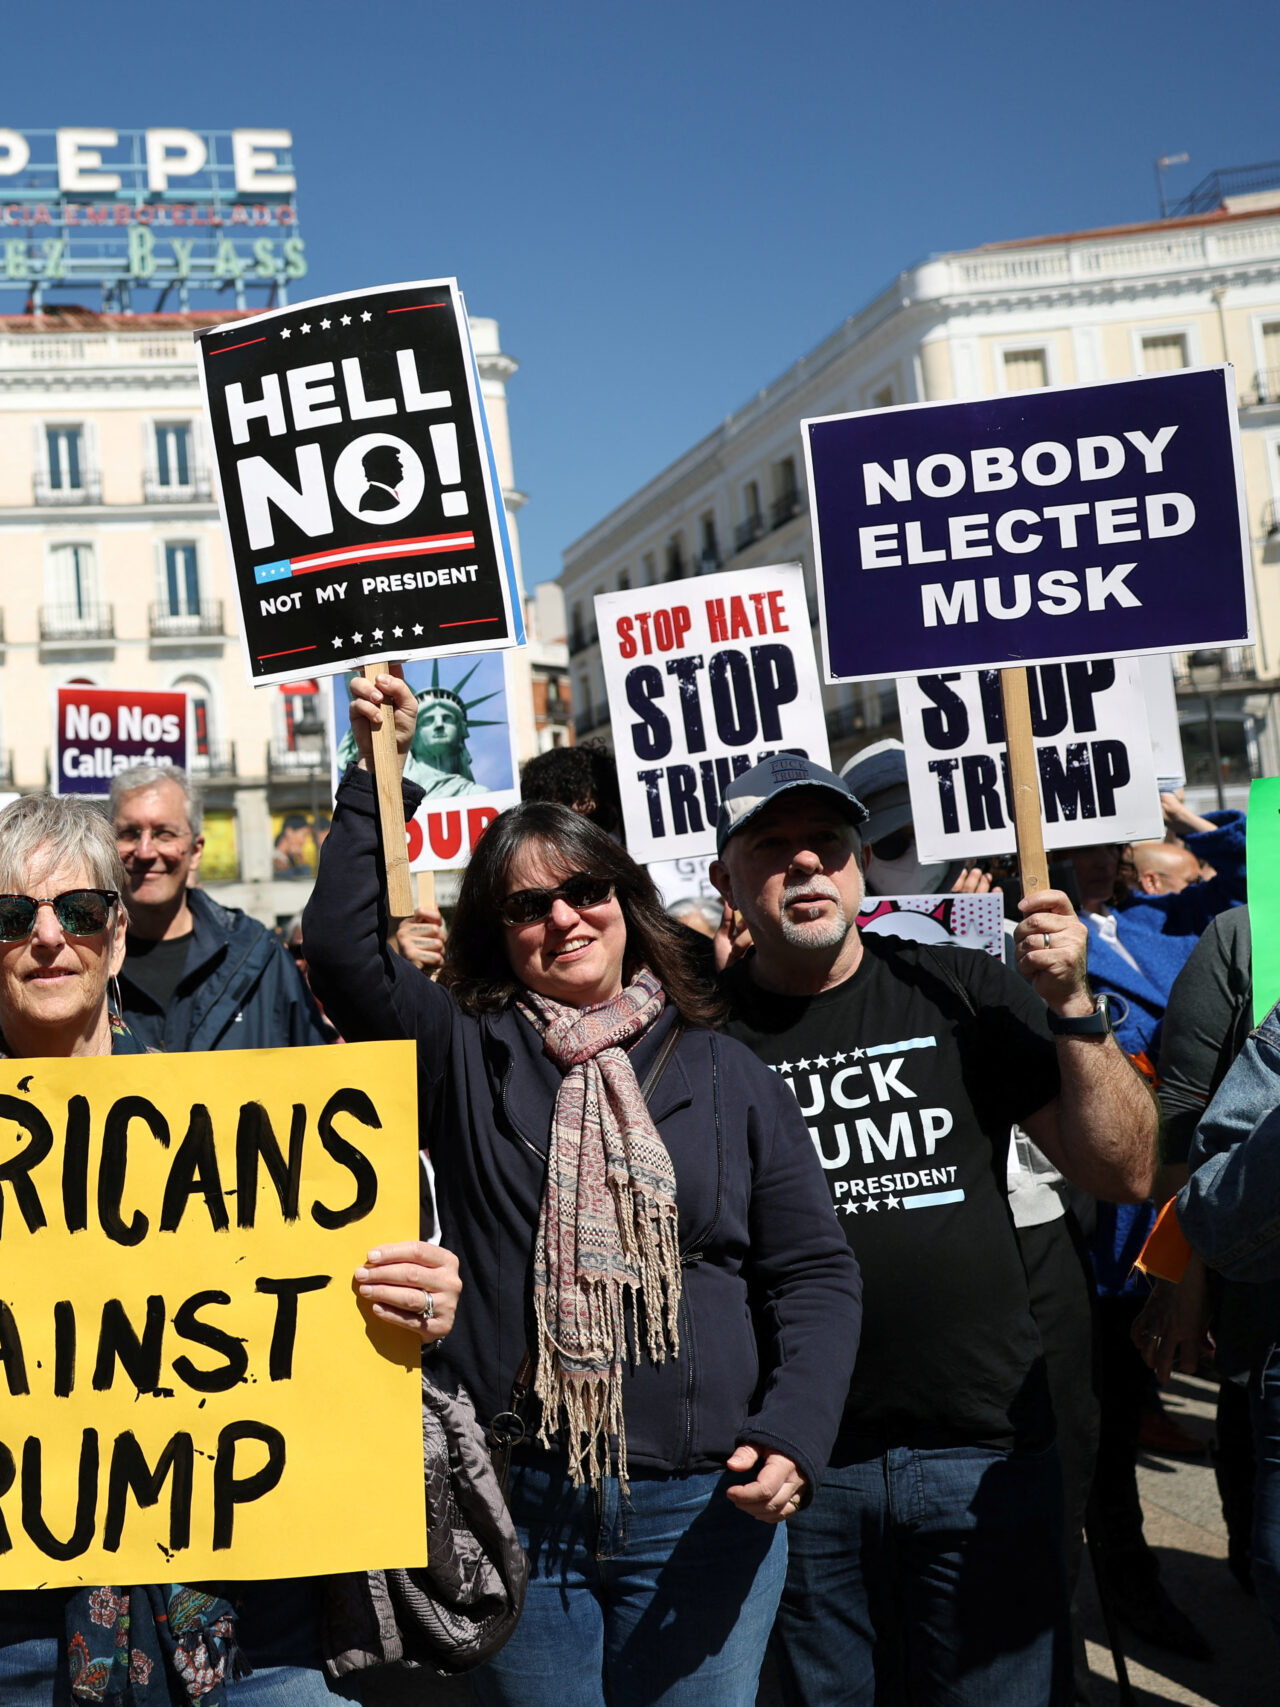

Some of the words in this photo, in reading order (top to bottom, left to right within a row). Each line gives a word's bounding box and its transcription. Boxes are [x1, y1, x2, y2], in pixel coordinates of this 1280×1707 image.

[65, 204, 297, 227] EMBOTELLADO
[128, 225, 307, 279] BYASS
[224, 348, 453, 446] HELL
[236, 422, 470, 551] NO!
[862, 425, 1179, 506] NOBODY
[858, 492, 1196, 570] ELECTED
[259, 591, 303, 617] NOT
[315, 581, 348, 605] MY
[362, 564, 479, 596] PRESIDENT
[920, 562, 1143, 628] MUSK
[616, 604, 691, 660] STOP
[705, 588, 789, 644] HATE
[65, 703, 111, 742] No
[117, 705, 180, 743] Nos
[624, 643, 798, 761] STOP
[637, 748, 810, 839] TRU
[770, 759, 806, 772] FUCK
[772, 769, 809, 783] TRUMP
[928, 740, 1131, 835] TRMP
[783, 1058, 918, 1117] UCK
[806, 1107, 953, 1170] UMP
[834, 1166, 957, 1198] PRESIDENT
